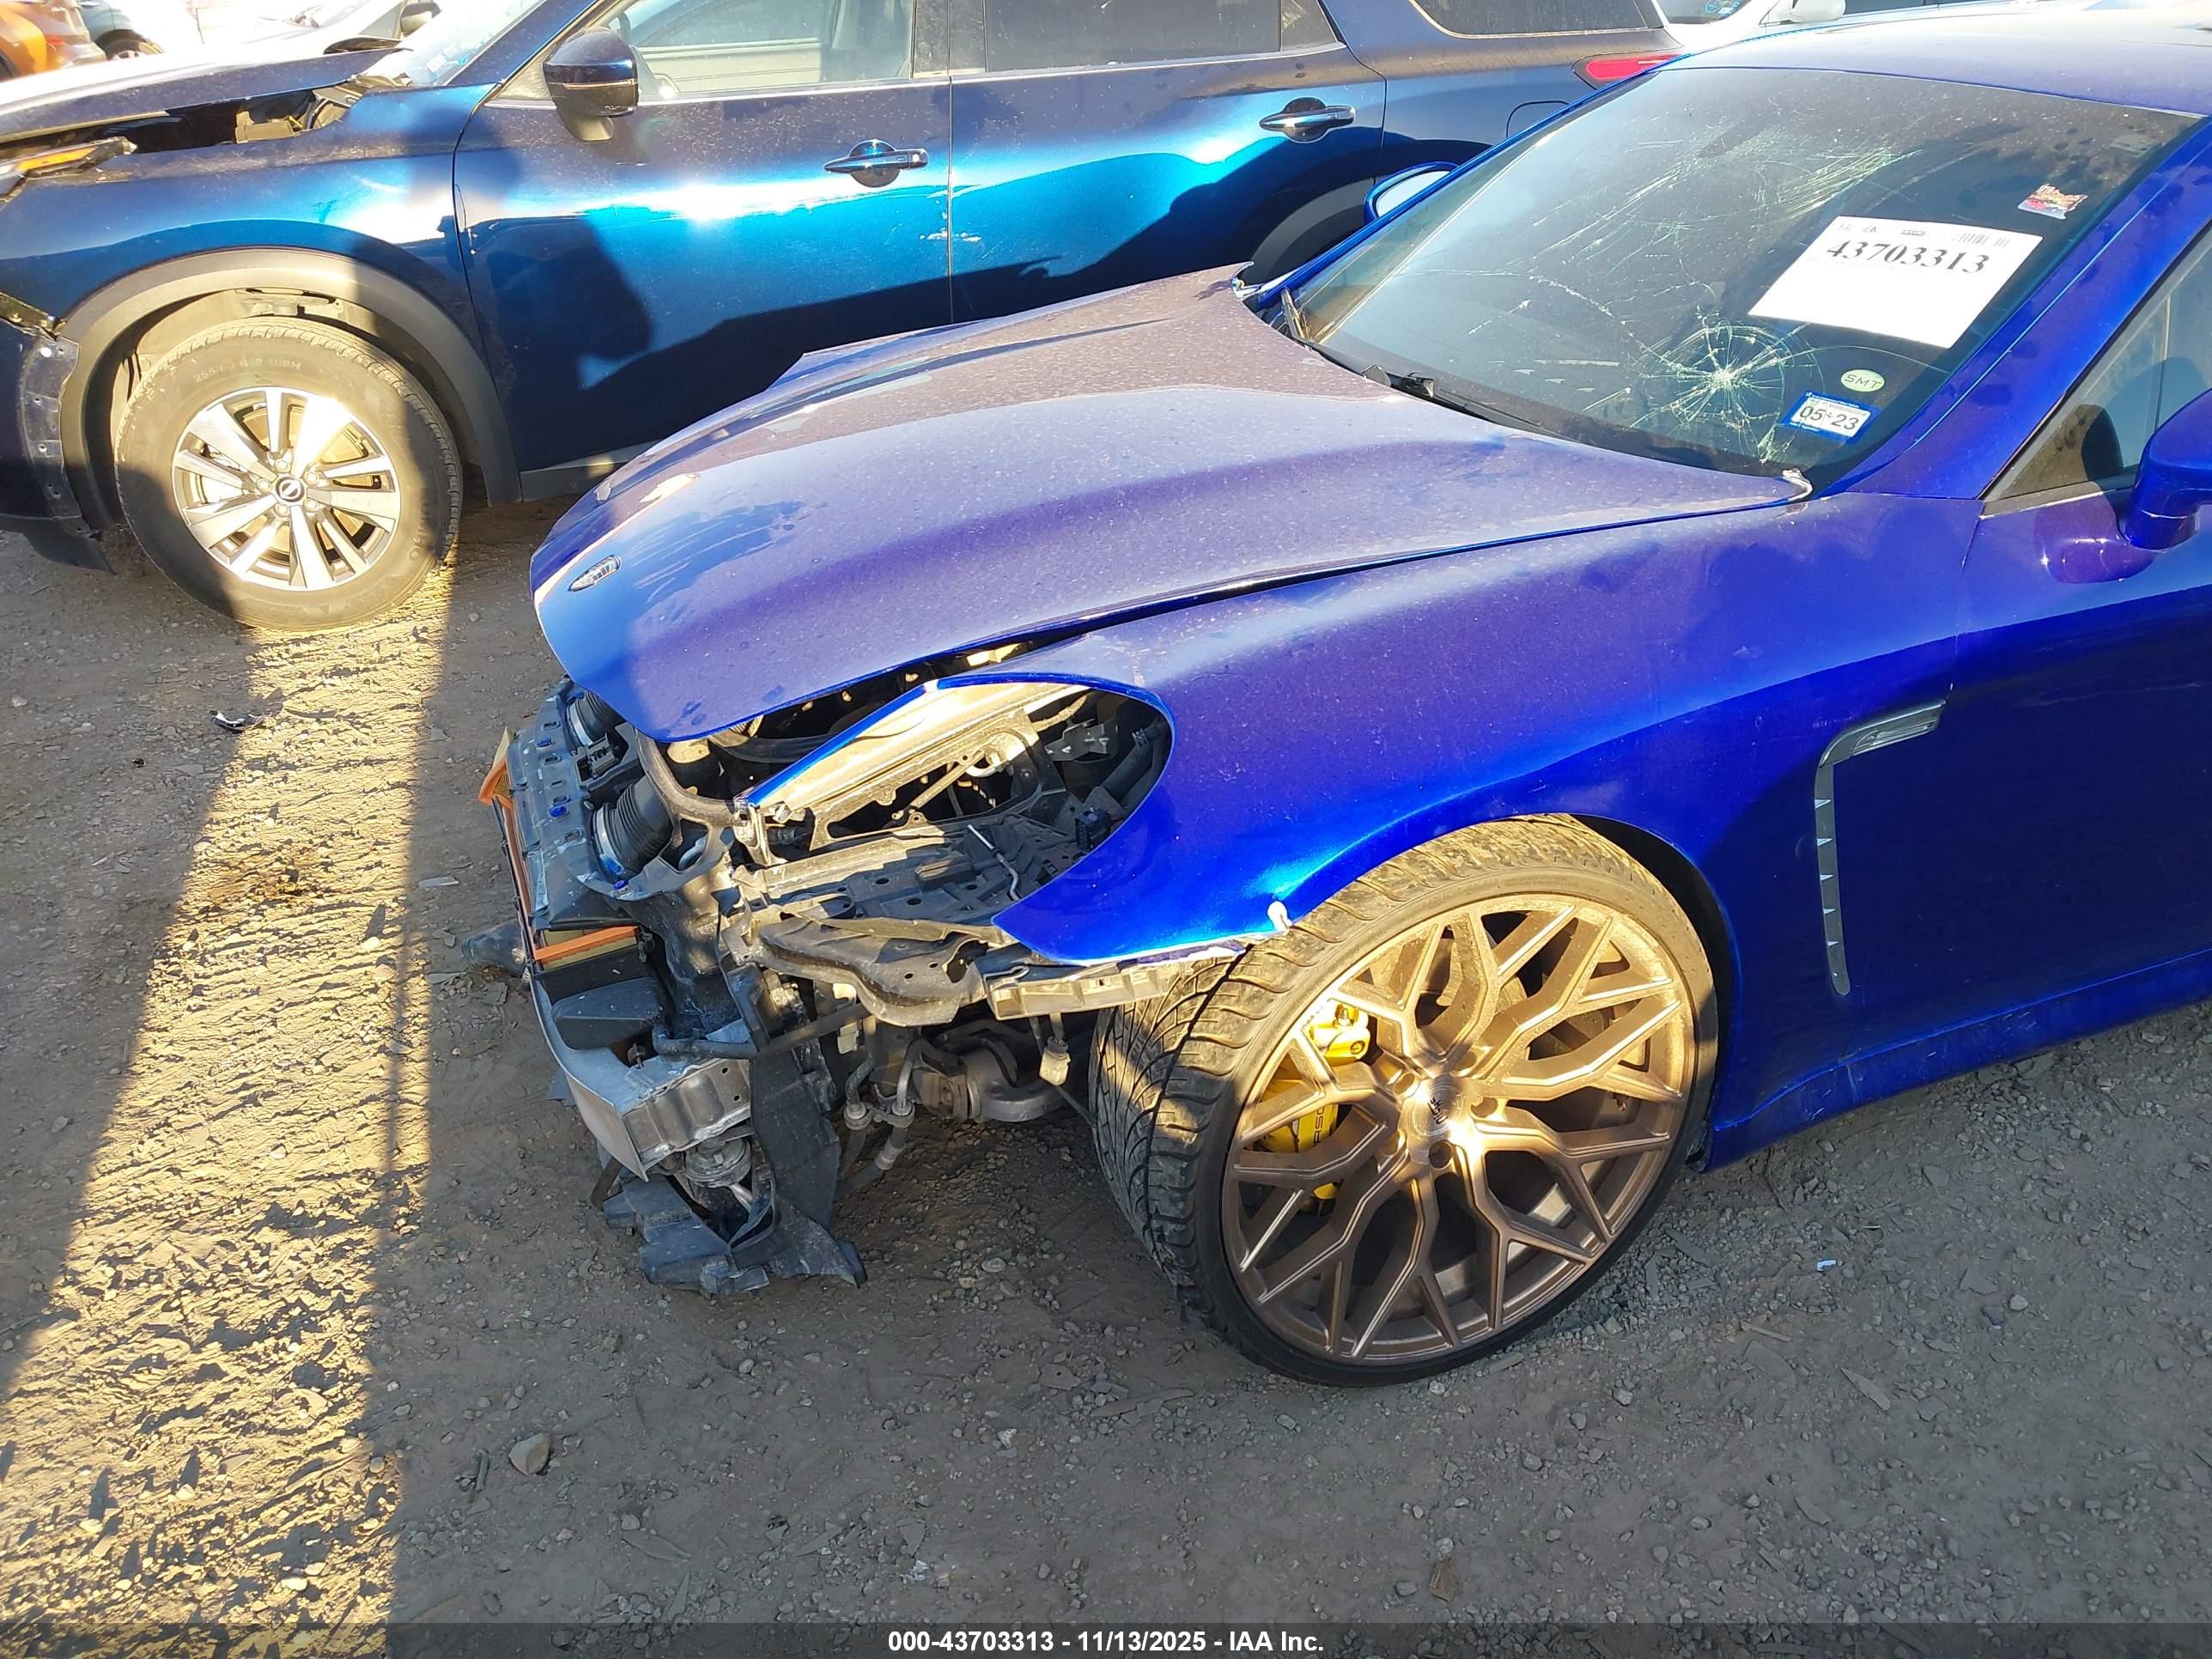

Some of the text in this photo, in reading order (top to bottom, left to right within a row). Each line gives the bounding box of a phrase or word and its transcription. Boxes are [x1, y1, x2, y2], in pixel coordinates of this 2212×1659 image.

[1826, 240, 1990, 273] 43703313
[1844, 374, 1882, 389] SMT
[1800, 405, 1826, 421] 05
[1831, 414, 1858, 430] 23
